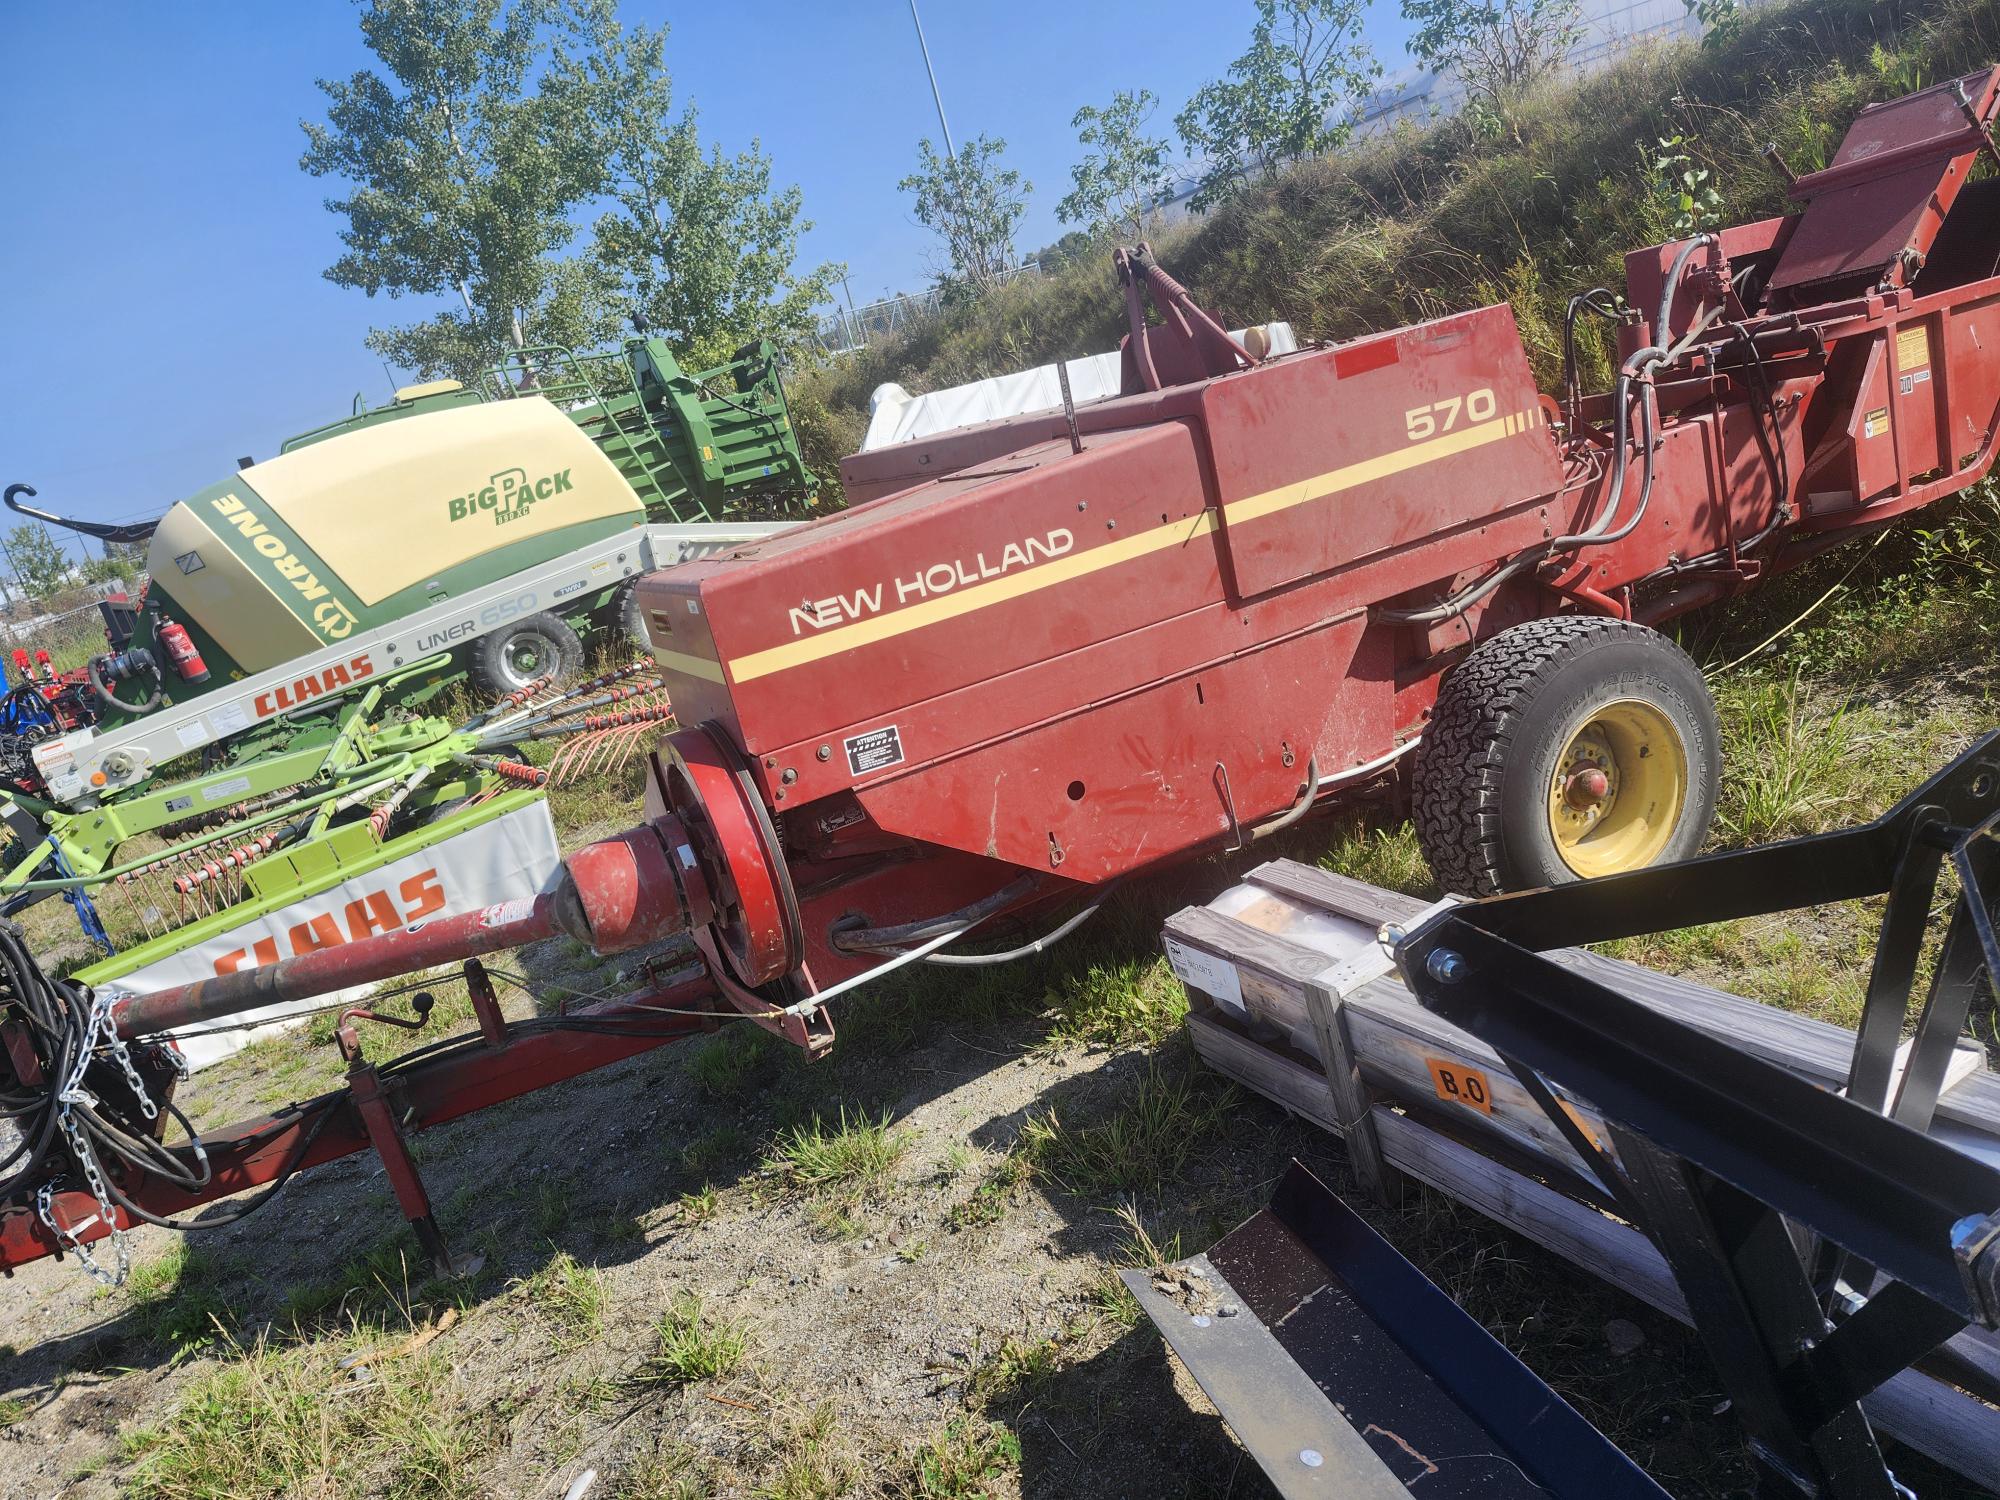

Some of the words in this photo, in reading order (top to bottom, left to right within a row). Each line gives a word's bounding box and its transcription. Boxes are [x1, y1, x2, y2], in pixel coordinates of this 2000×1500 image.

[1405, 388, 1496, 440] 570
[211, 493, 331, 601] KRONE
[560, 582, 582, 596] TWIN
[788, 583, 882, 635] NEW
[894, 528, 1074, 604] HOLLAND
[417, 620, 477, 652] LINER
[479, 592, 539, 627] 650
[254, 654, 375, 719] CLAAS
[856, 731, 888, 747] ATTENTION
